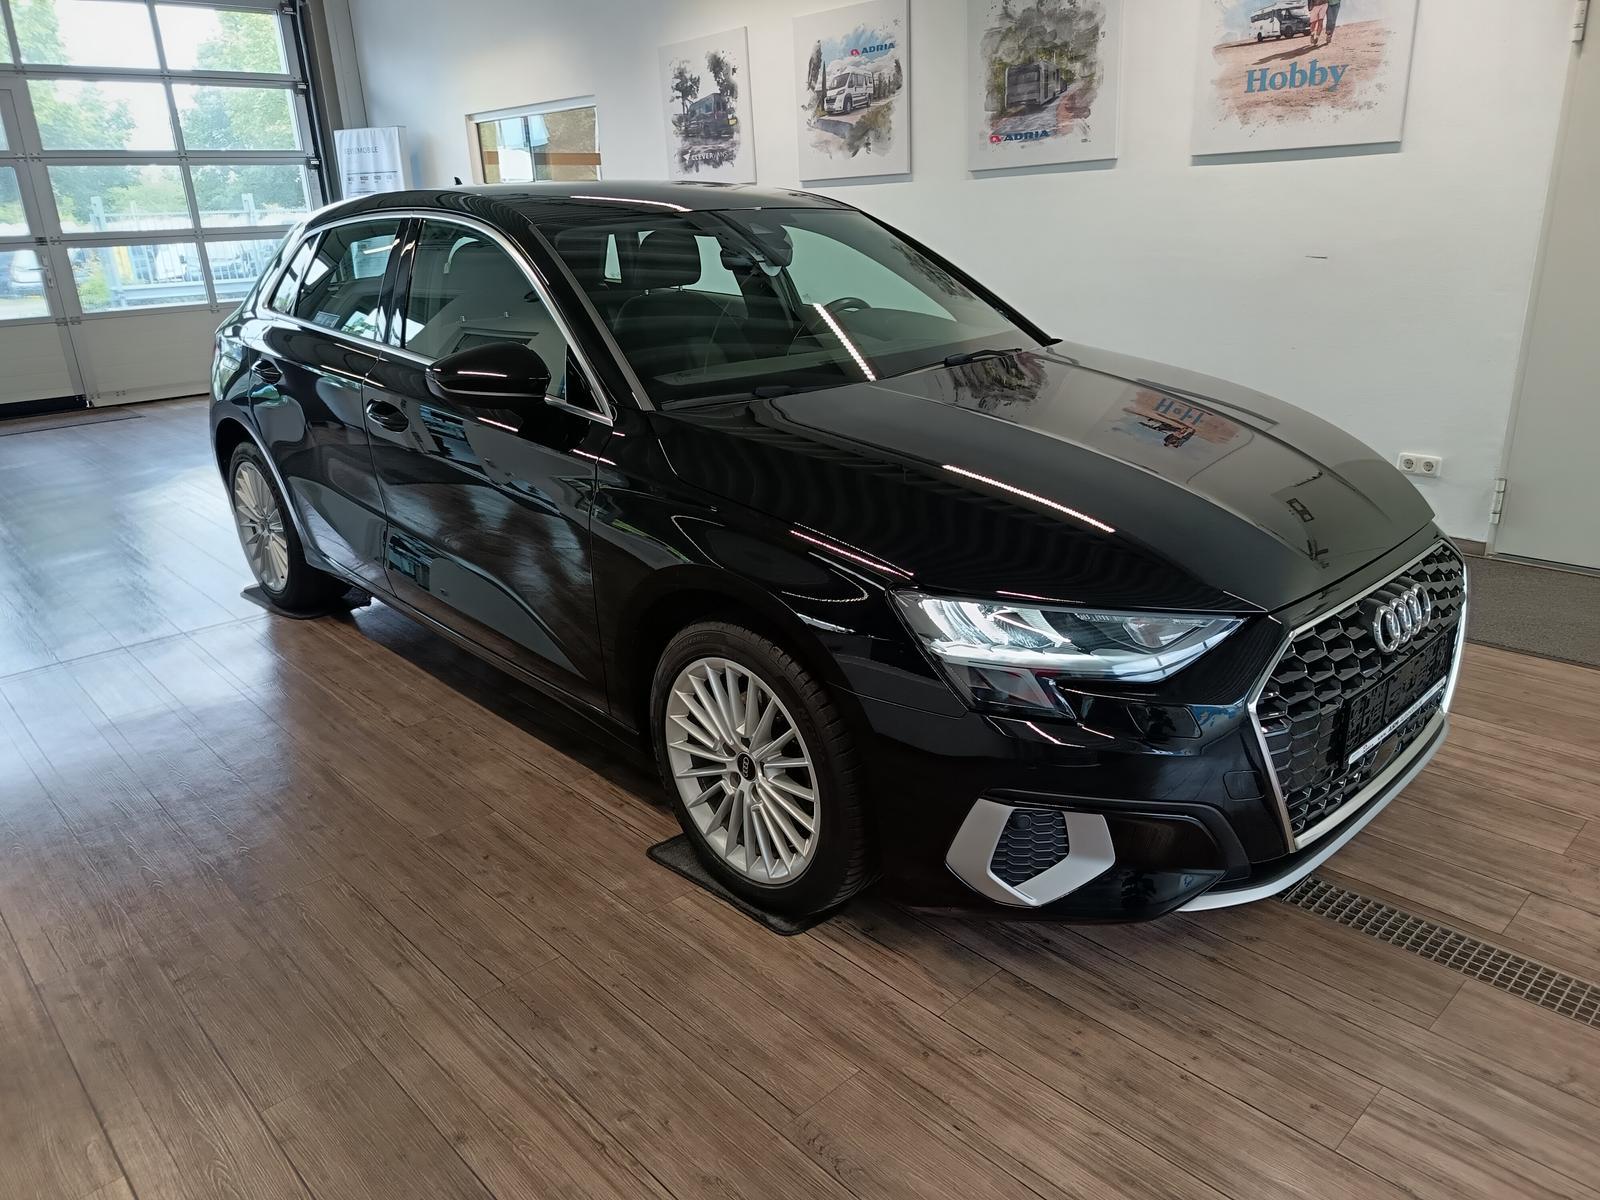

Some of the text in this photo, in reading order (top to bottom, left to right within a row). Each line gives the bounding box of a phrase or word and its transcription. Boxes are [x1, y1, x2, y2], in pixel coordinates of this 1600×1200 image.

[862, 42, 895, 54] ADRIA
[1244, 59, 1349, 93] Hobby
[1004, 130, 1049, 142] ADRIA
